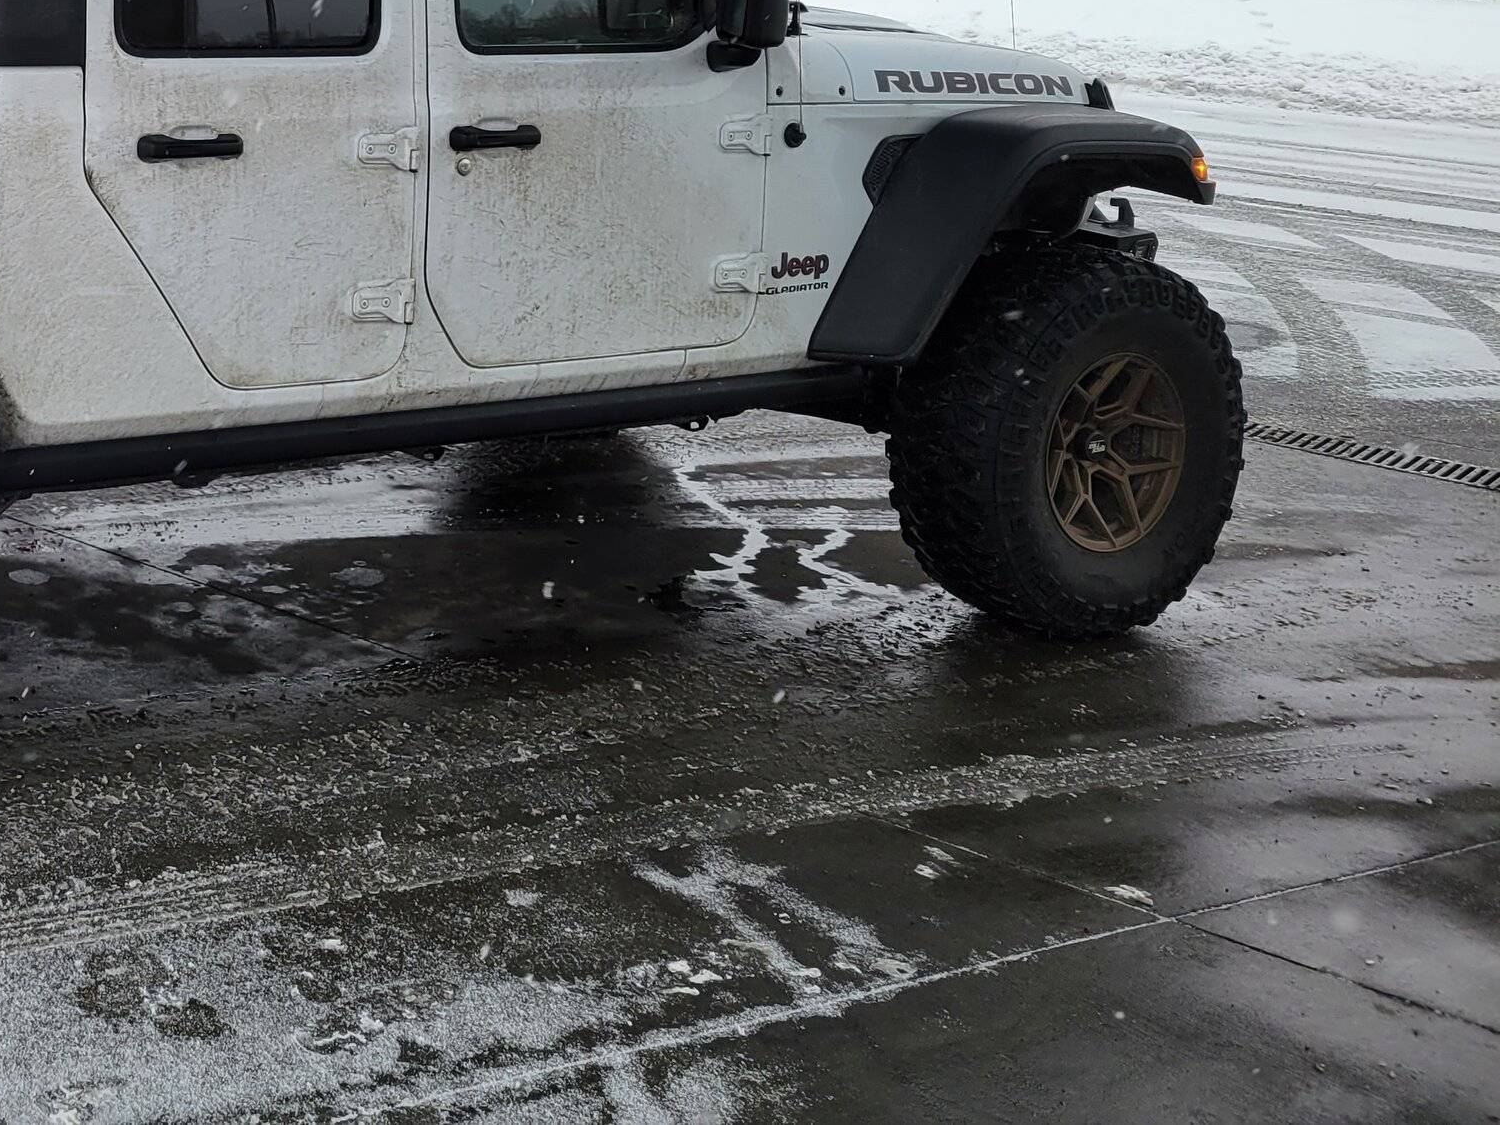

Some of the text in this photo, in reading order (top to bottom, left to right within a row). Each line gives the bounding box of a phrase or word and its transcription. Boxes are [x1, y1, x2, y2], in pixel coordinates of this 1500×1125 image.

[874, 69, 1074, 97] RUBICON
[771, 252, 829, 280] Jeep
[766, 282, 829, 296] GLADIATOR
